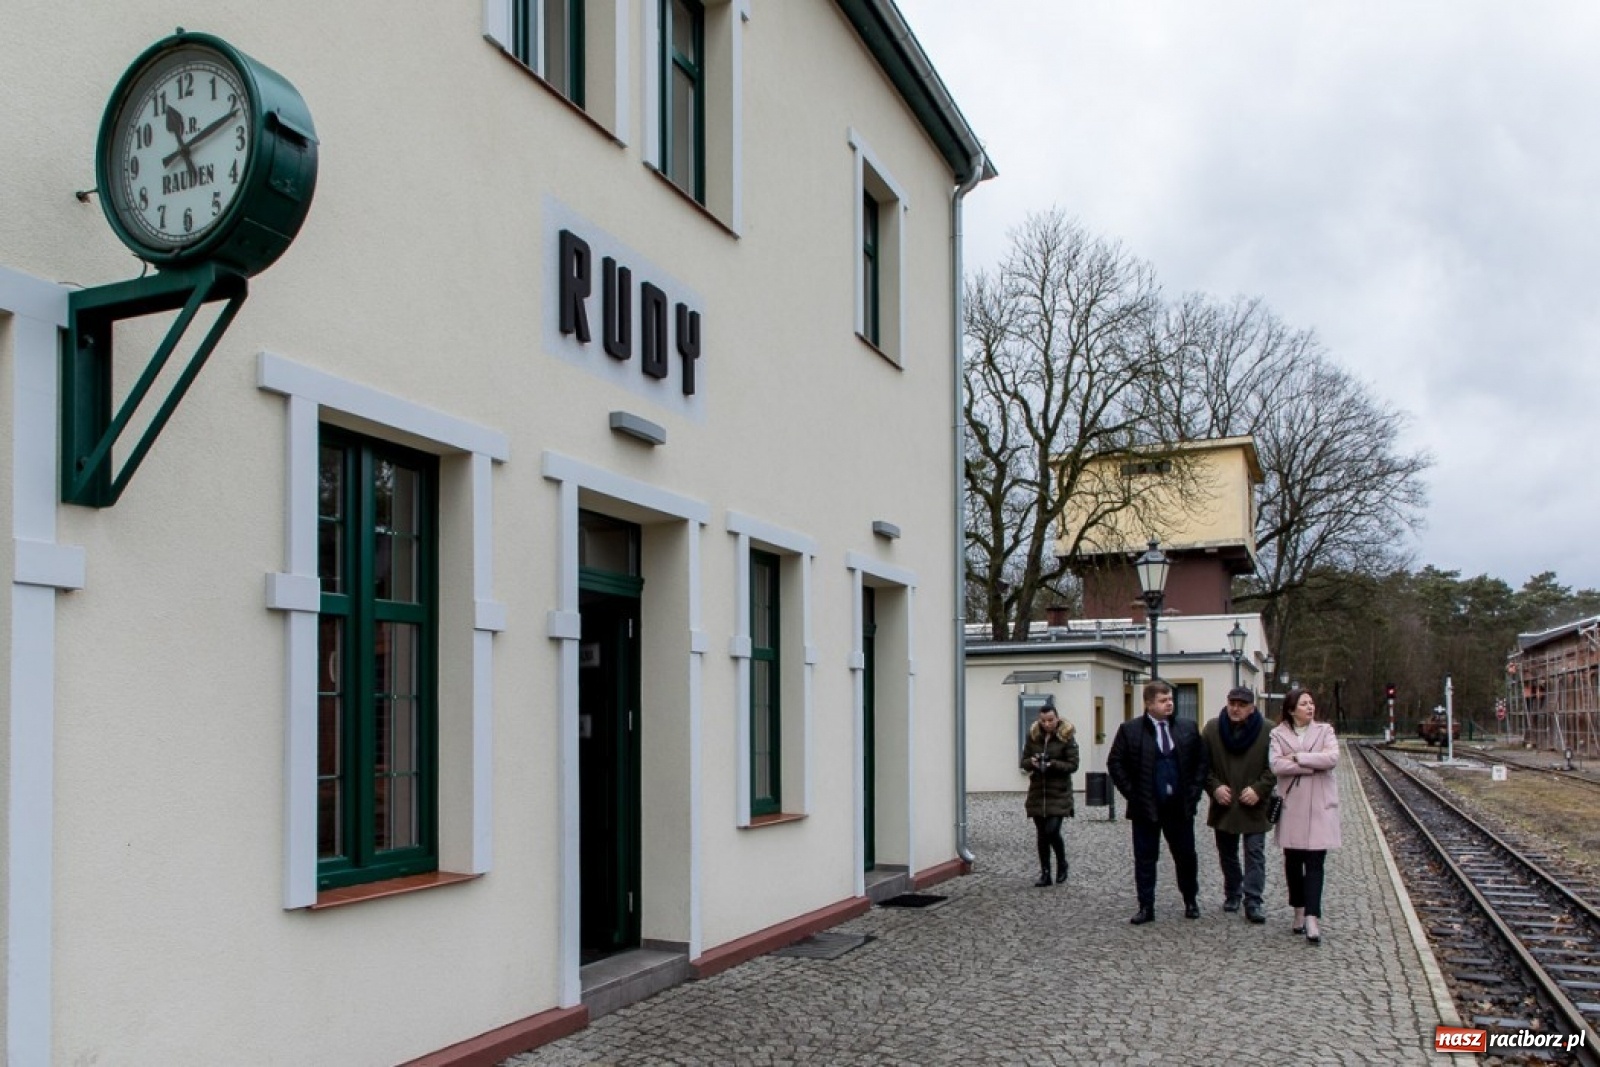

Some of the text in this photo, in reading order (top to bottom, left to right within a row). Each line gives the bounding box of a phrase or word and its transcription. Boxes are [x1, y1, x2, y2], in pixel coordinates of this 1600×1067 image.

[176, 72, 194, 100] 12
[209, 75, 217, 101] 1
[152, 90, 167, 117] 11
[227, 93, 237, 116] 2
[136, 123, 152, 149] 10
[235, 125, 245, 151] 3
[130, 155, 139, 180] 9
[162, 163, 214, 195] RAUDEN
[228, 158, 238, 184] 4
[139, 186, 149, 211] 8
[211, 191, 221, 217] 5
[157, 204, 166, 229] 7
[183, 207, 193, 232] 6
[559, 229, 701, 396] RUDY
